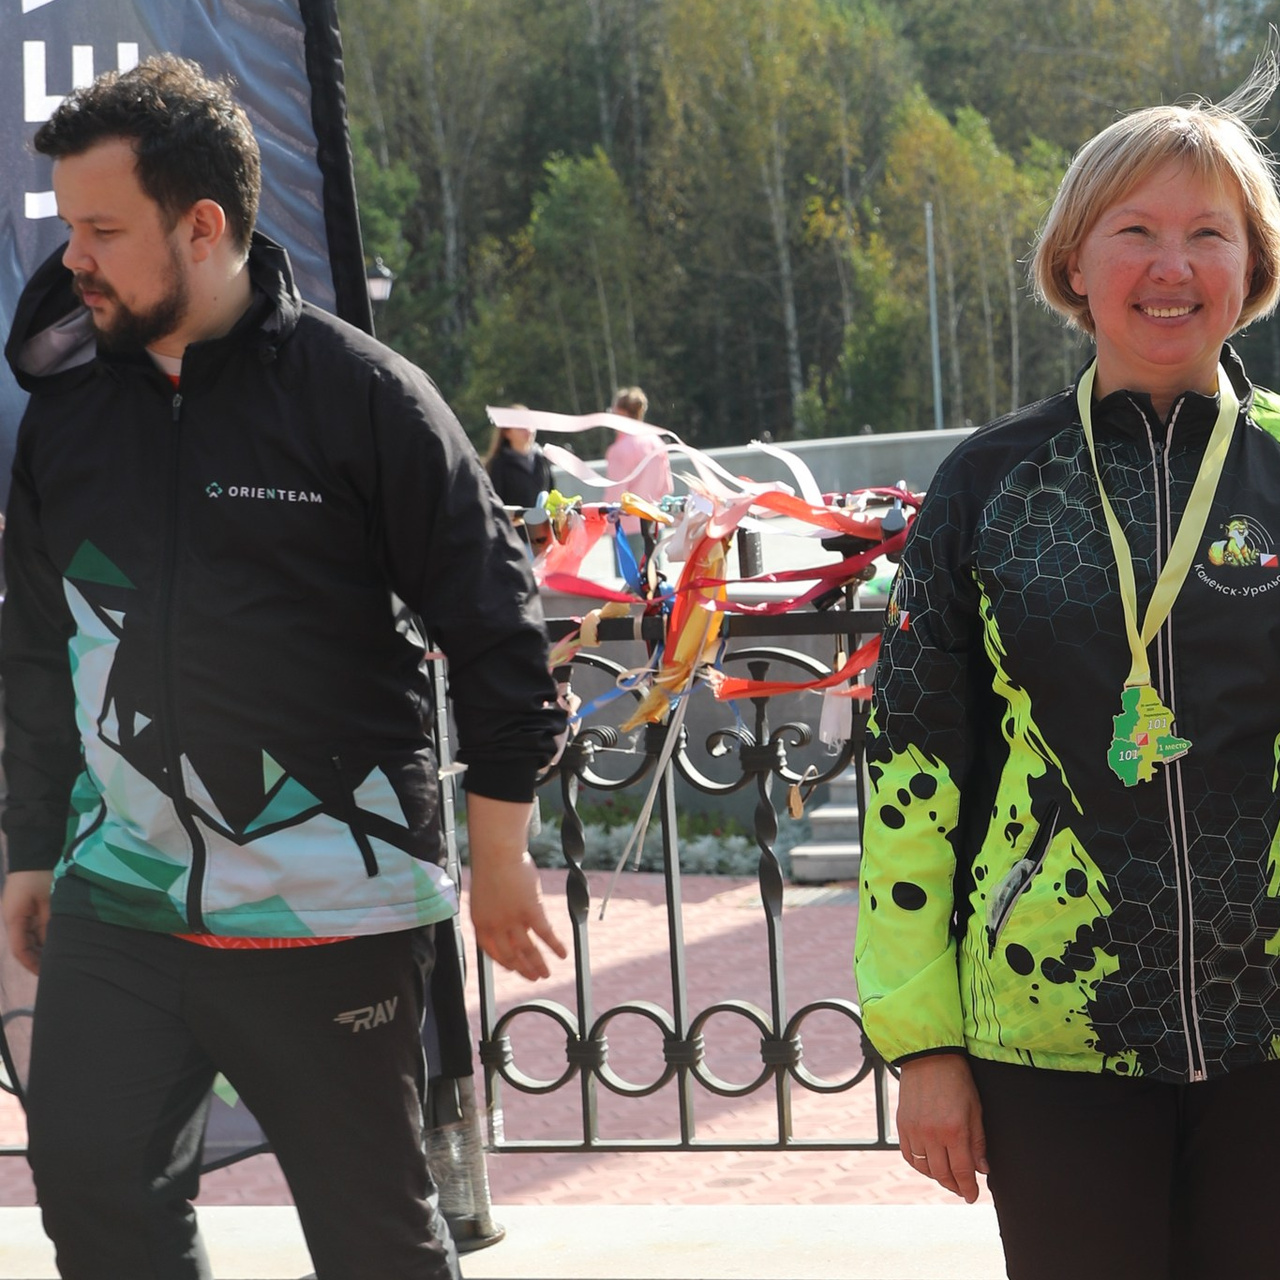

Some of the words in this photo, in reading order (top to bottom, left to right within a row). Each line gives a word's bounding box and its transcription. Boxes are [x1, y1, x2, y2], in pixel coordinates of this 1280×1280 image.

[228, 485, 323, 503] ORIENTEAM
[1148, 718, 1167, 730] 101
[1118, 750, 1139, 762] 101
[333, 995, 399, 1033] RAY
